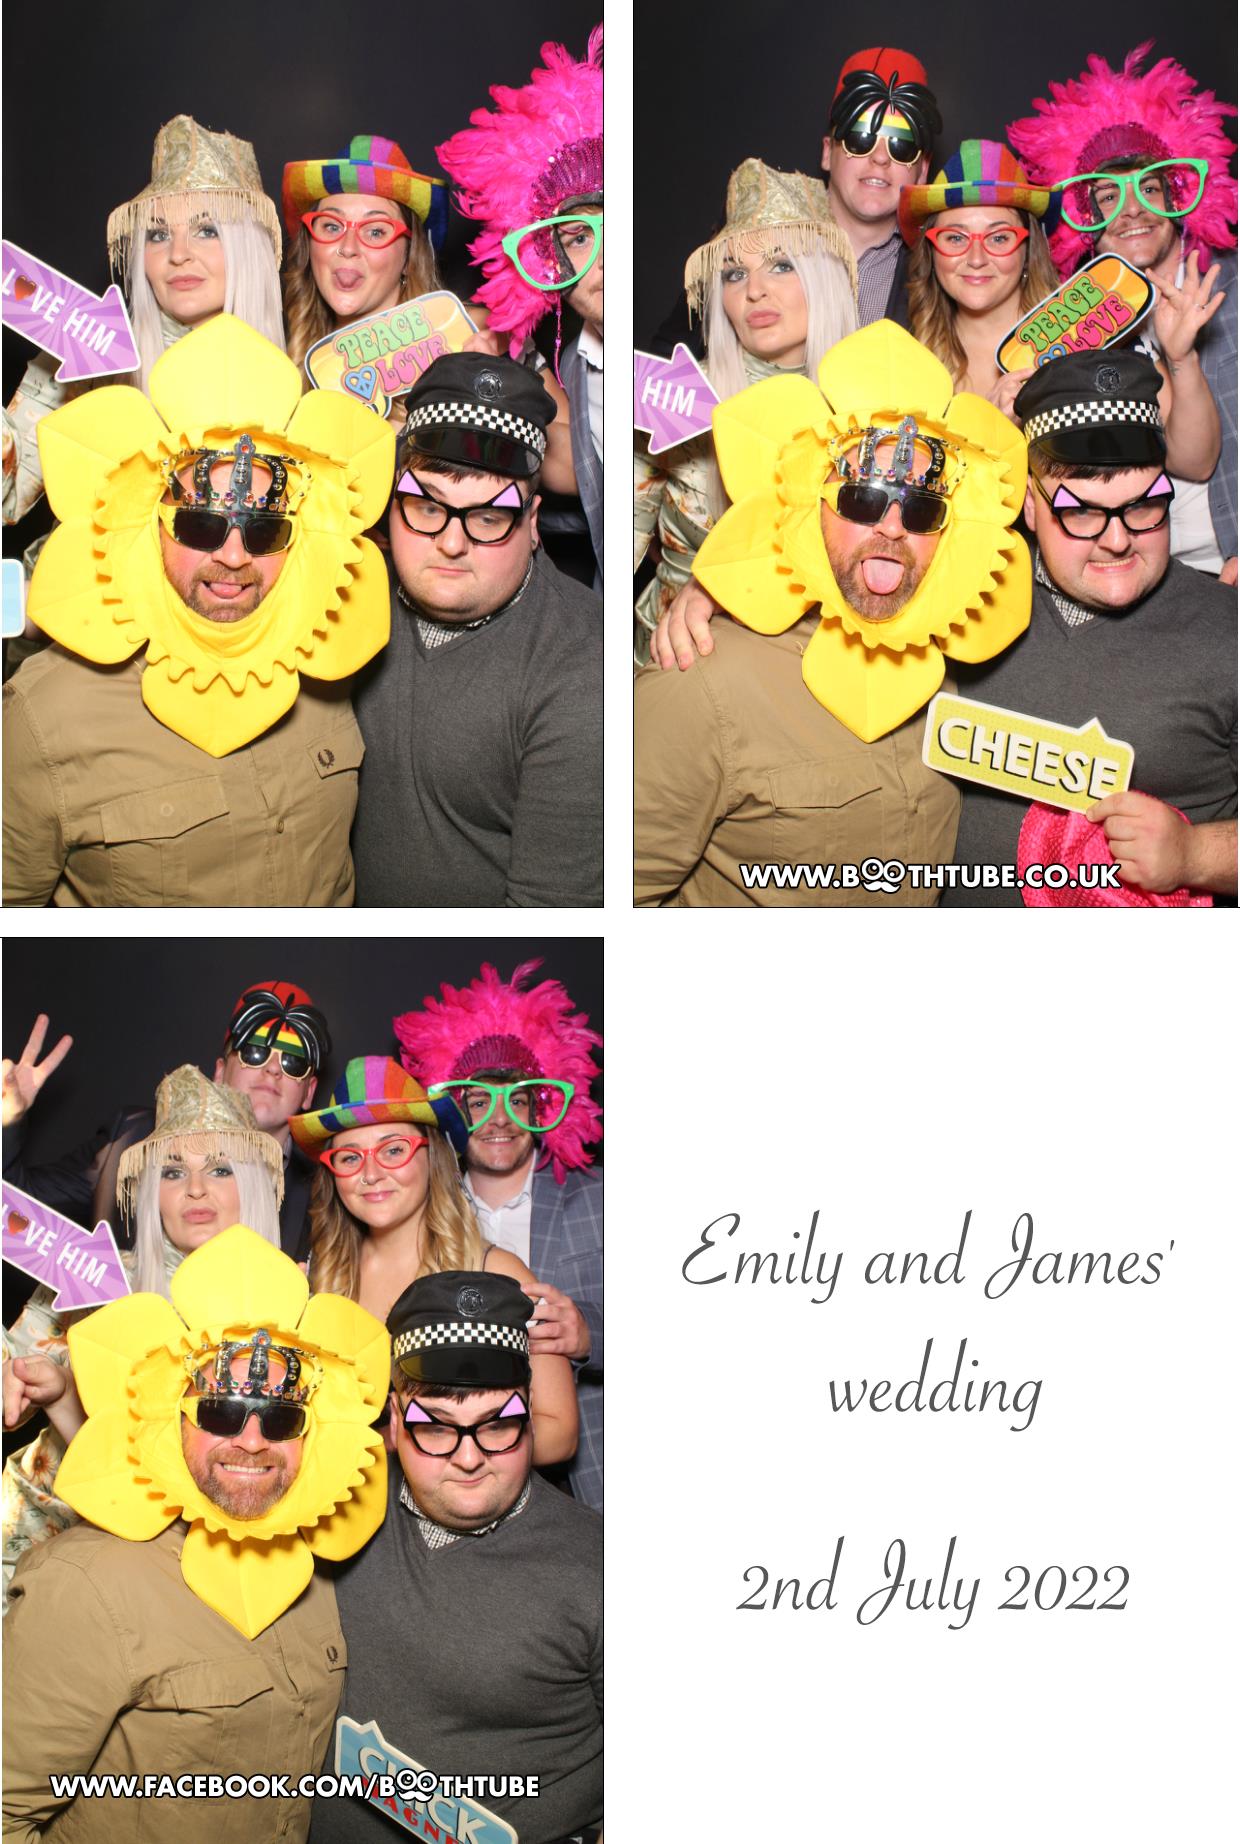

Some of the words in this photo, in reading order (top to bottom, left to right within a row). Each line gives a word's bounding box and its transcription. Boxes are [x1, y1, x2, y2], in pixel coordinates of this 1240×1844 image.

[62, 307, 117, 356] HIM
[336, 305, 430, 368] PEACE
[1020, 275, 1105, 352] PEACE
[1062, 295, 1132, 352] LOVE
[641, 376, 697, 417] HIM
[938, 717, 1120, 800] CHEESE
[56, 1242, 109, 1288] HIM
